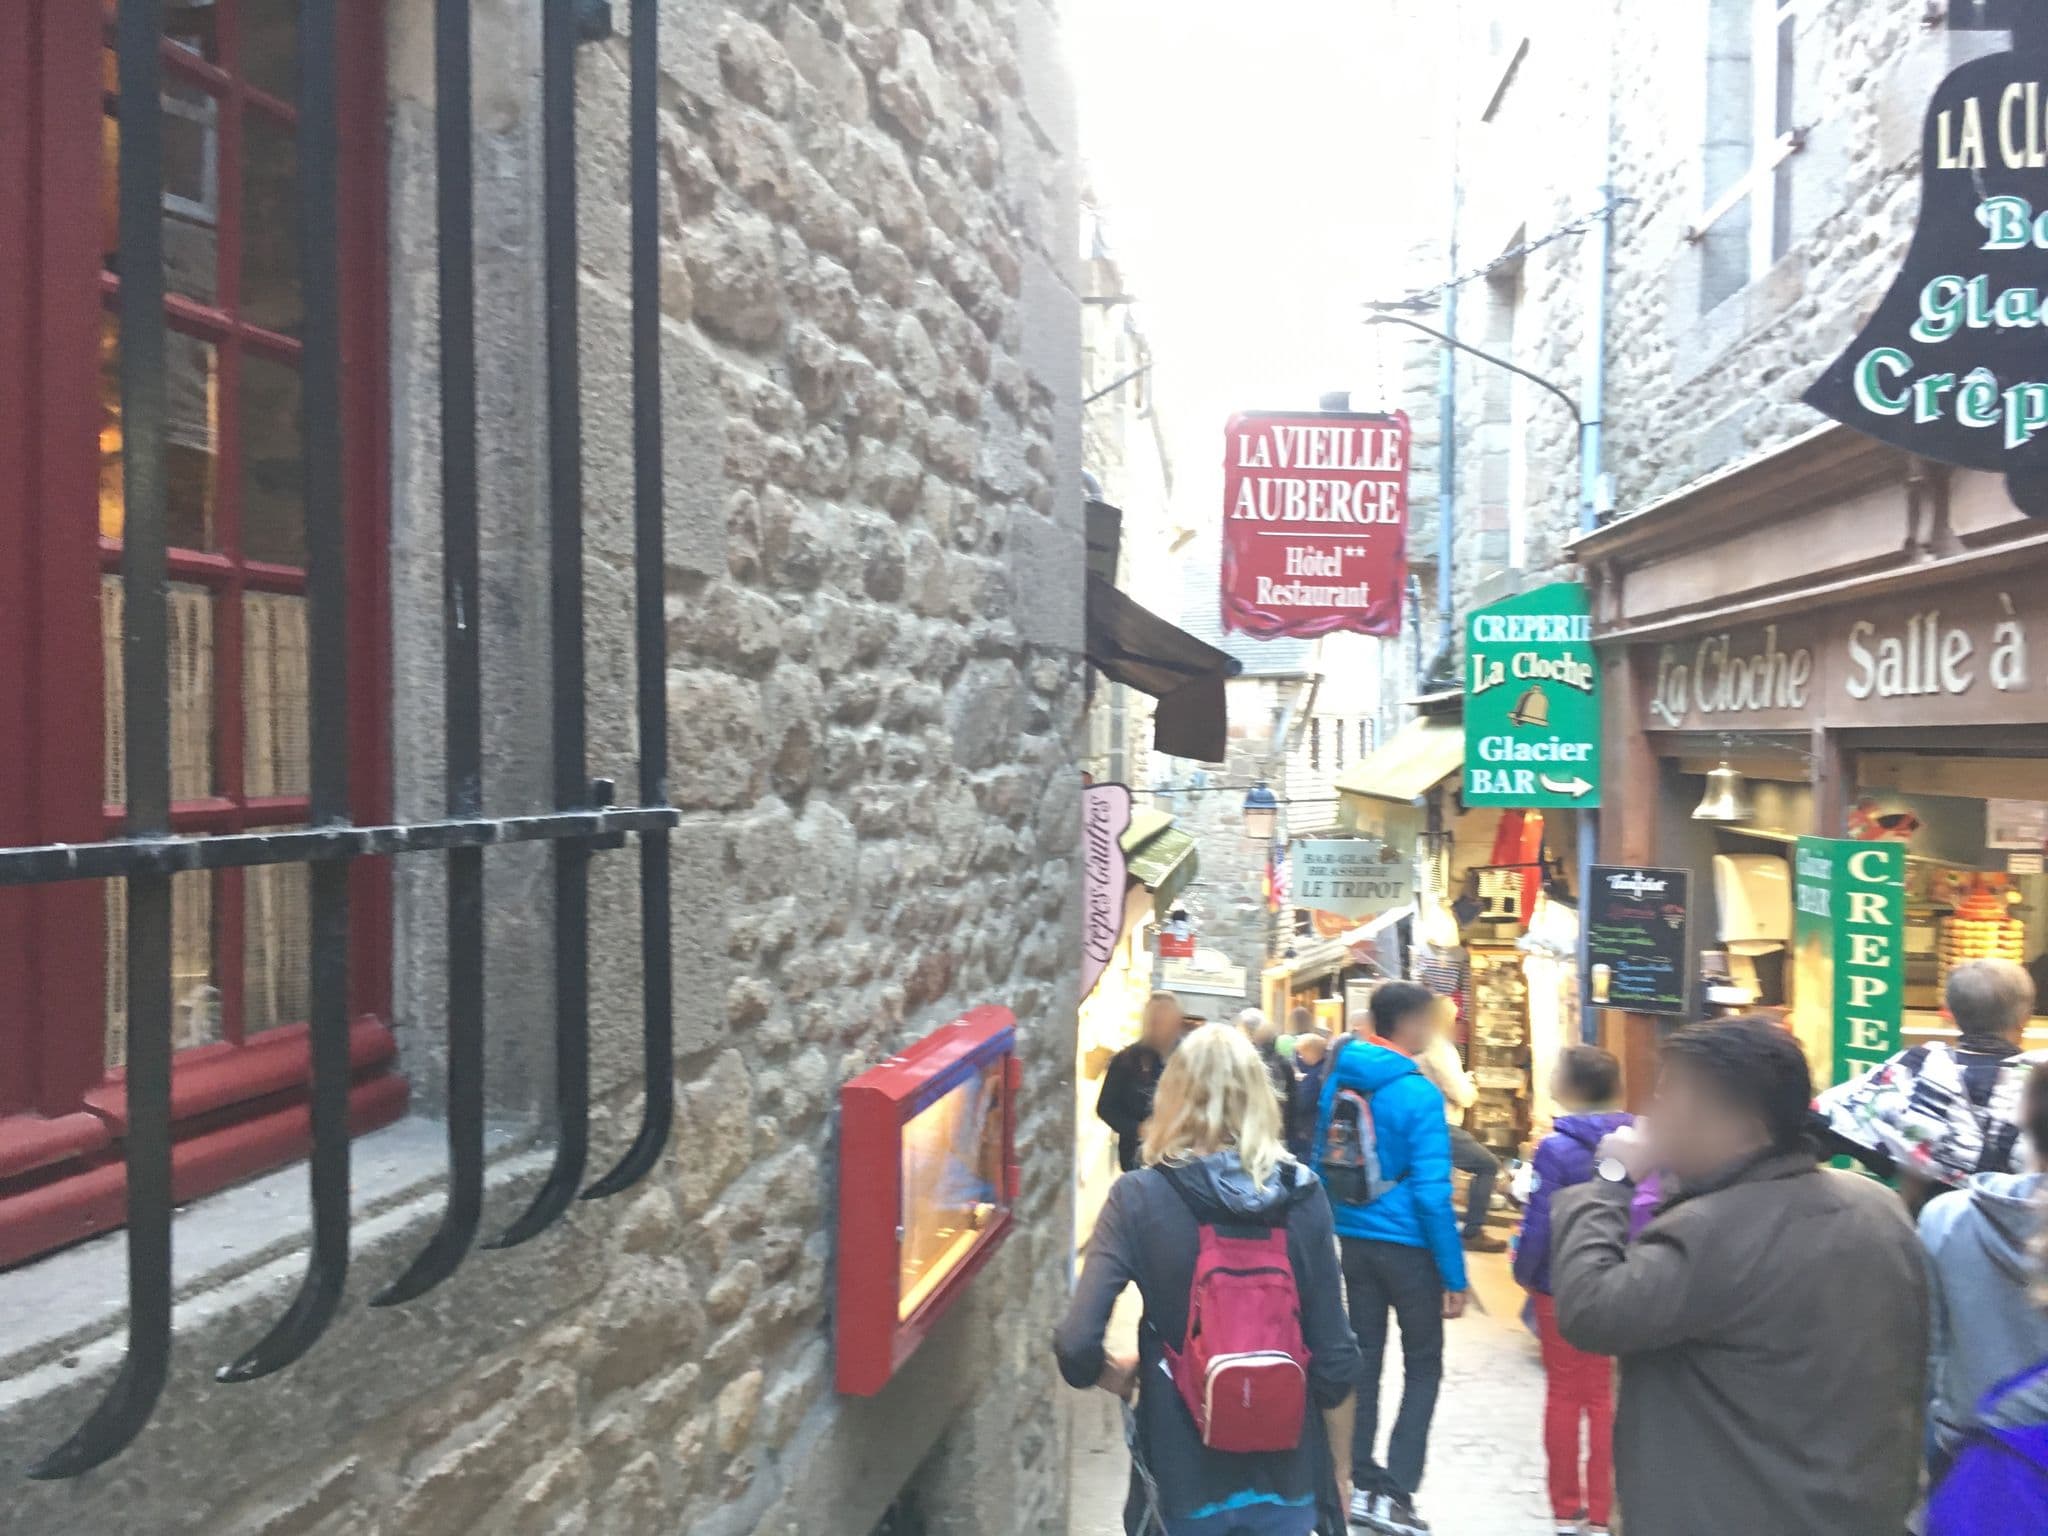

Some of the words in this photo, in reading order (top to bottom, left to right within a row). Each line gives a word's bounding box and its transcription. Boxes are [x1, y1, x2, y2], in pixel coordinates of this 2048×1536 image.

[1937, 97, 1986, 169] LA
[1999, 82, 2048, 169] CL
[1238, 434, 1272, 467] LA
[1271, 425, 1402, 471] VIEILLE
[1231, 477, 1400, 524] AUBERGE
[1256, 576, 1370, 607] Restaurant
[1846, 610, 1973, 699] Salle
[1989, 592, 2028, 691] à
[1471, 654, 1504, 694] La
[1511, 652, 1593, 691] Cloche
[1650, 644, 1690, 728] La
[1695, 624, 1811, 713] Cloche
[1478, 736, 1593, 762] Glacier
[1470, 769, 1536, 794] BAR
[1302, 881, 1324, 897] LE
[1330, 881, 1404, 898] TRIPOT
